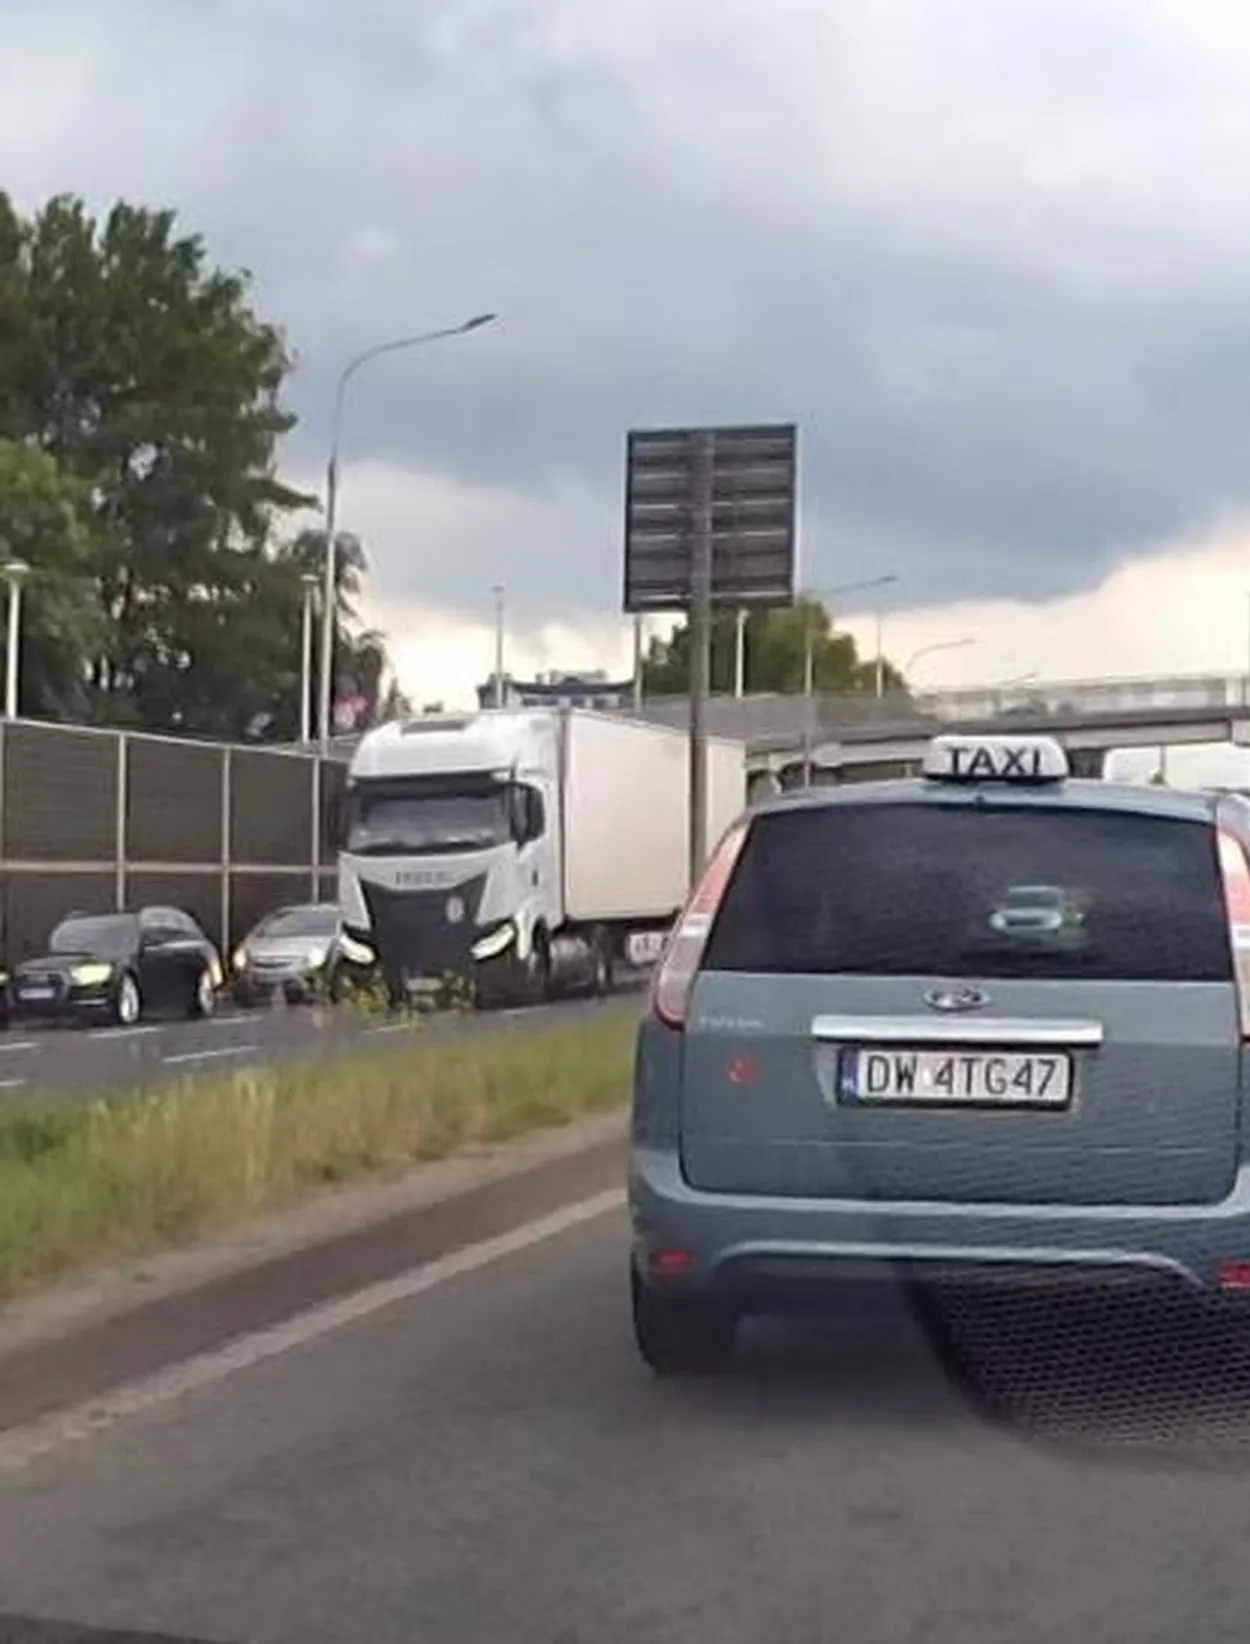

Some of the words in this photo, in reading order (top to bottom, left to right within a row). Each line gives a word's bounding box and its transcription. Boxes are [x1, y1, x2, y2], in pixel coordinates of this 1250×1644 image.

[948, 746, 1041, 776] TAXI
[867, 1055, 918, 1094] DW
[934, 1056, 1056, 1097] 4TG47
